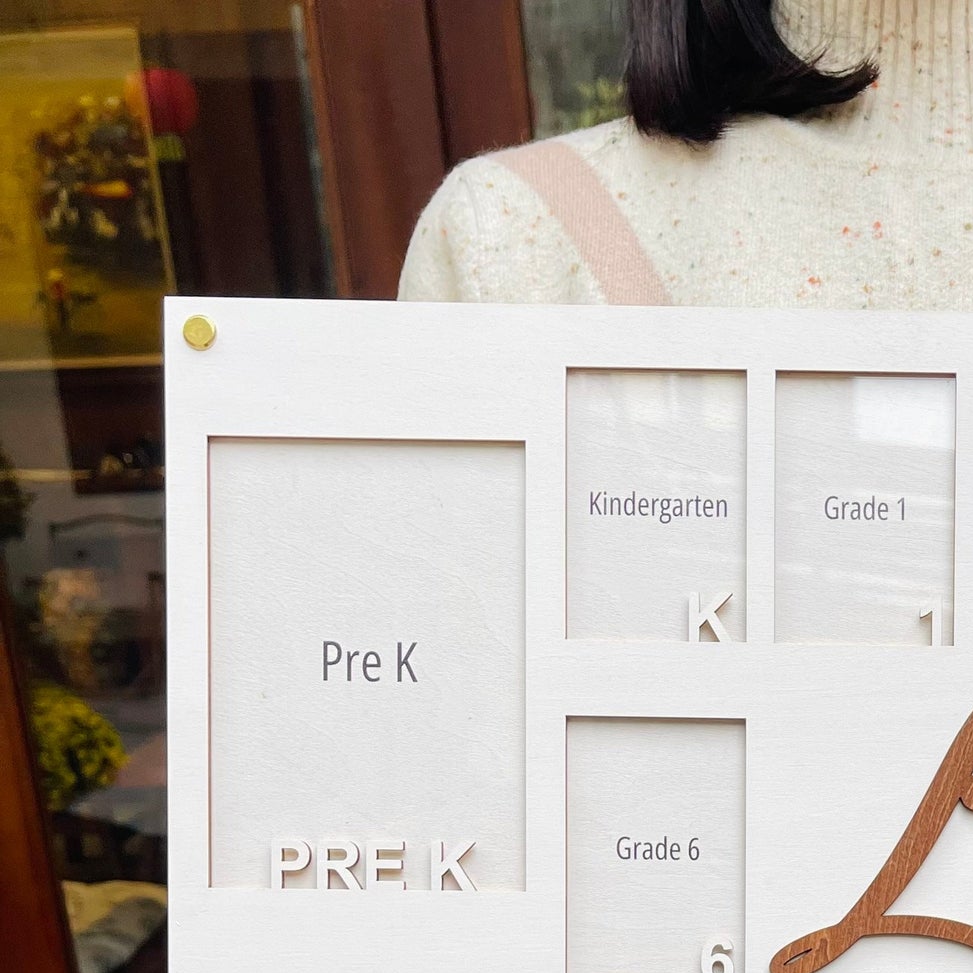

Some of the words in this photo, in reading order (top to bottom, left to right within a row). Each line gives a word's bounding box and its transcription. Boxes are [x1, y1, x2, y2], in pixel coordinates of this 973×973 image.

[589, 490, 728, 525] Kindergarten
[824, 495, 889, 521] Grade
[897, 497, 905, 521] 1
[689, 591, 734, 642] K
[919, 597, 942, 645] 1
[322, 640, 382, 683] Pre
[396, 641, 418, 683] K
[270, 838, 406, 891] PRE
[431, 840, 477, 891] K
[616, 835, 681, 861] Grade
[688, 837, 700, 861] 6
